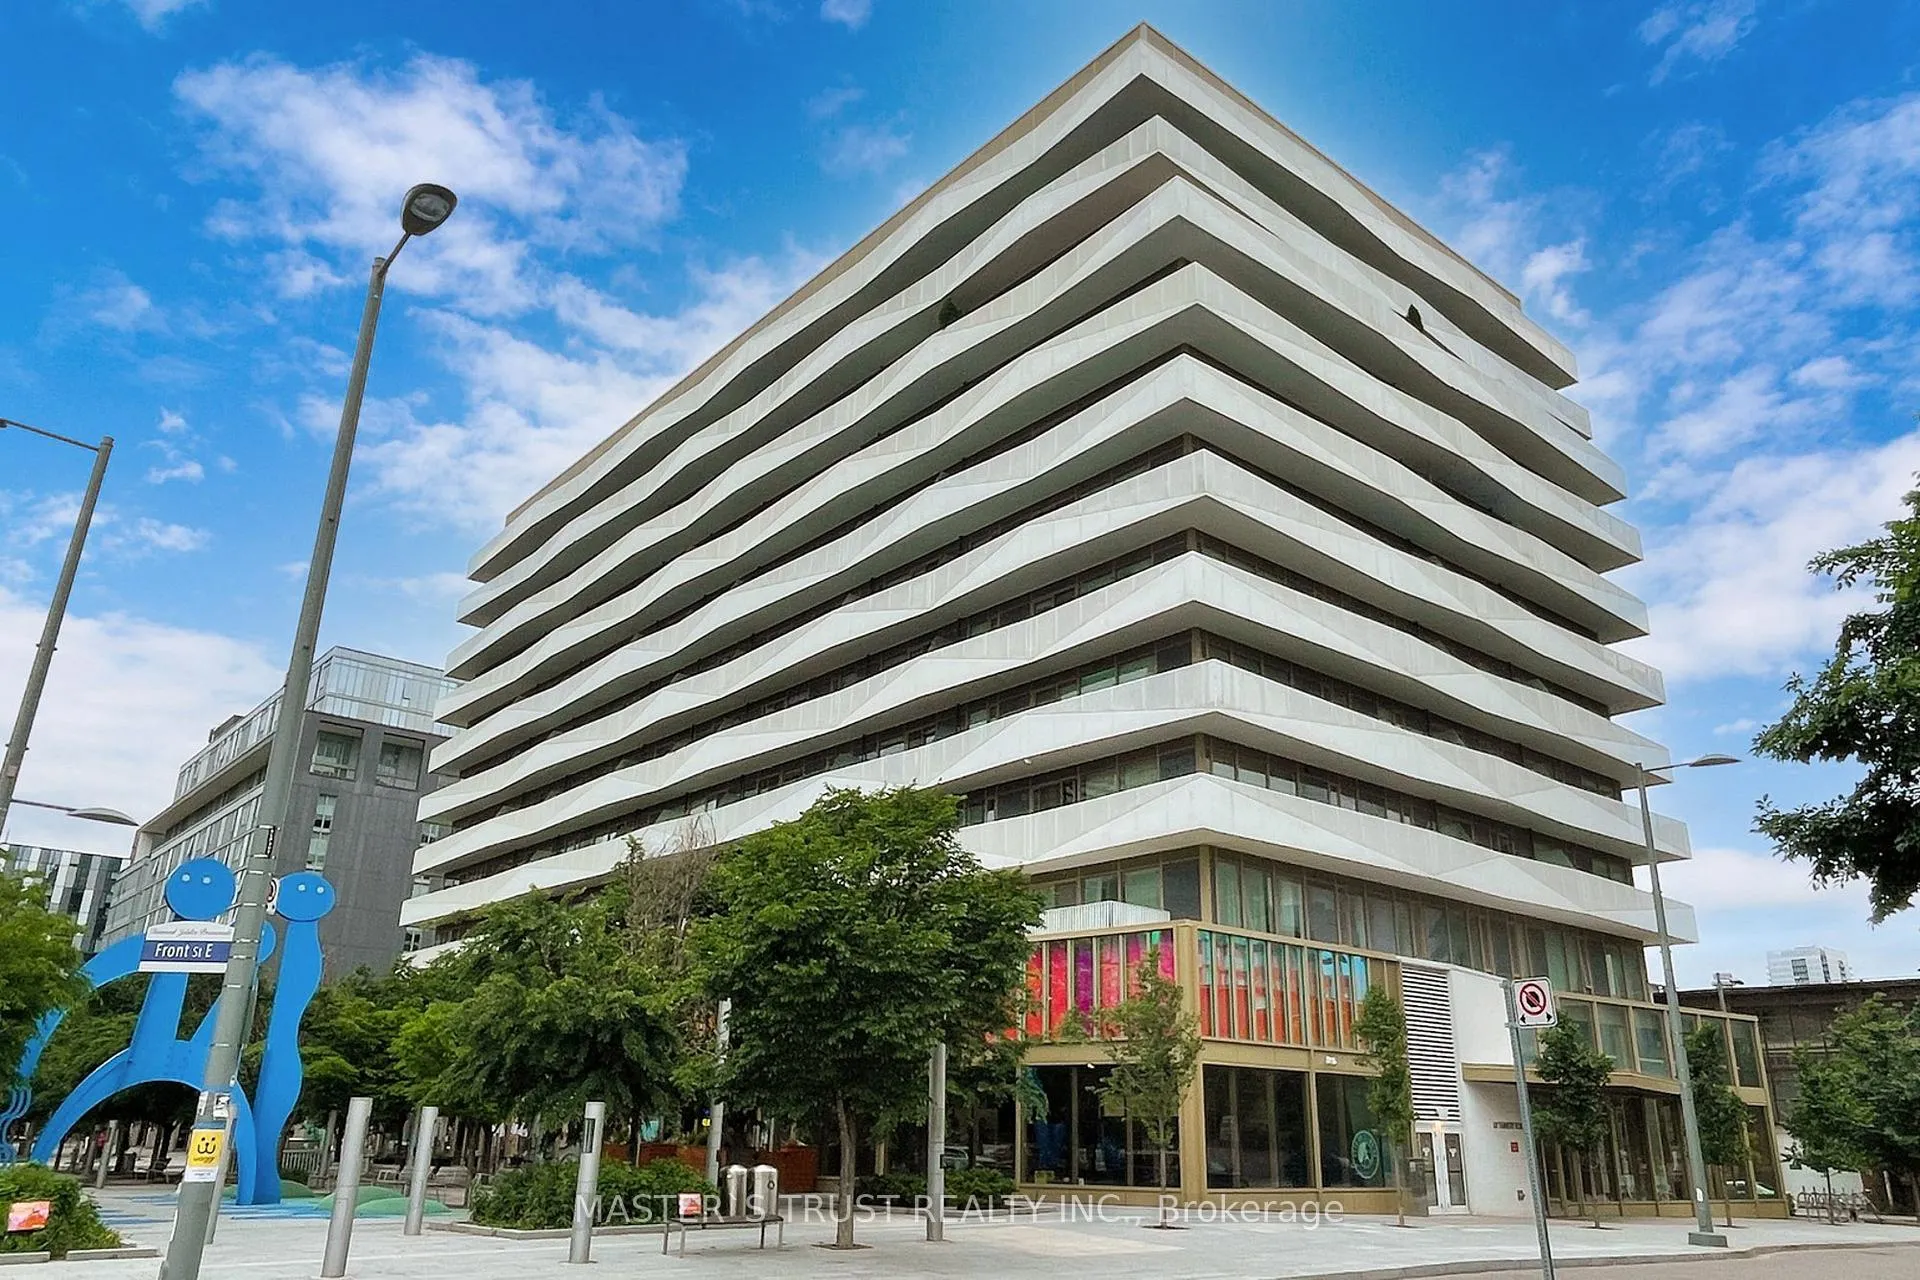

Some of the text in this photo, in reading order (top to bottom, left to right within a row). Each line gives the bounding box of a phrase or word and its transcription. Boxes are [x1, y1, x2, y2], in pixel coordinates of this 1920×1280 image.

[154, 943, 214, 958] Front St E
